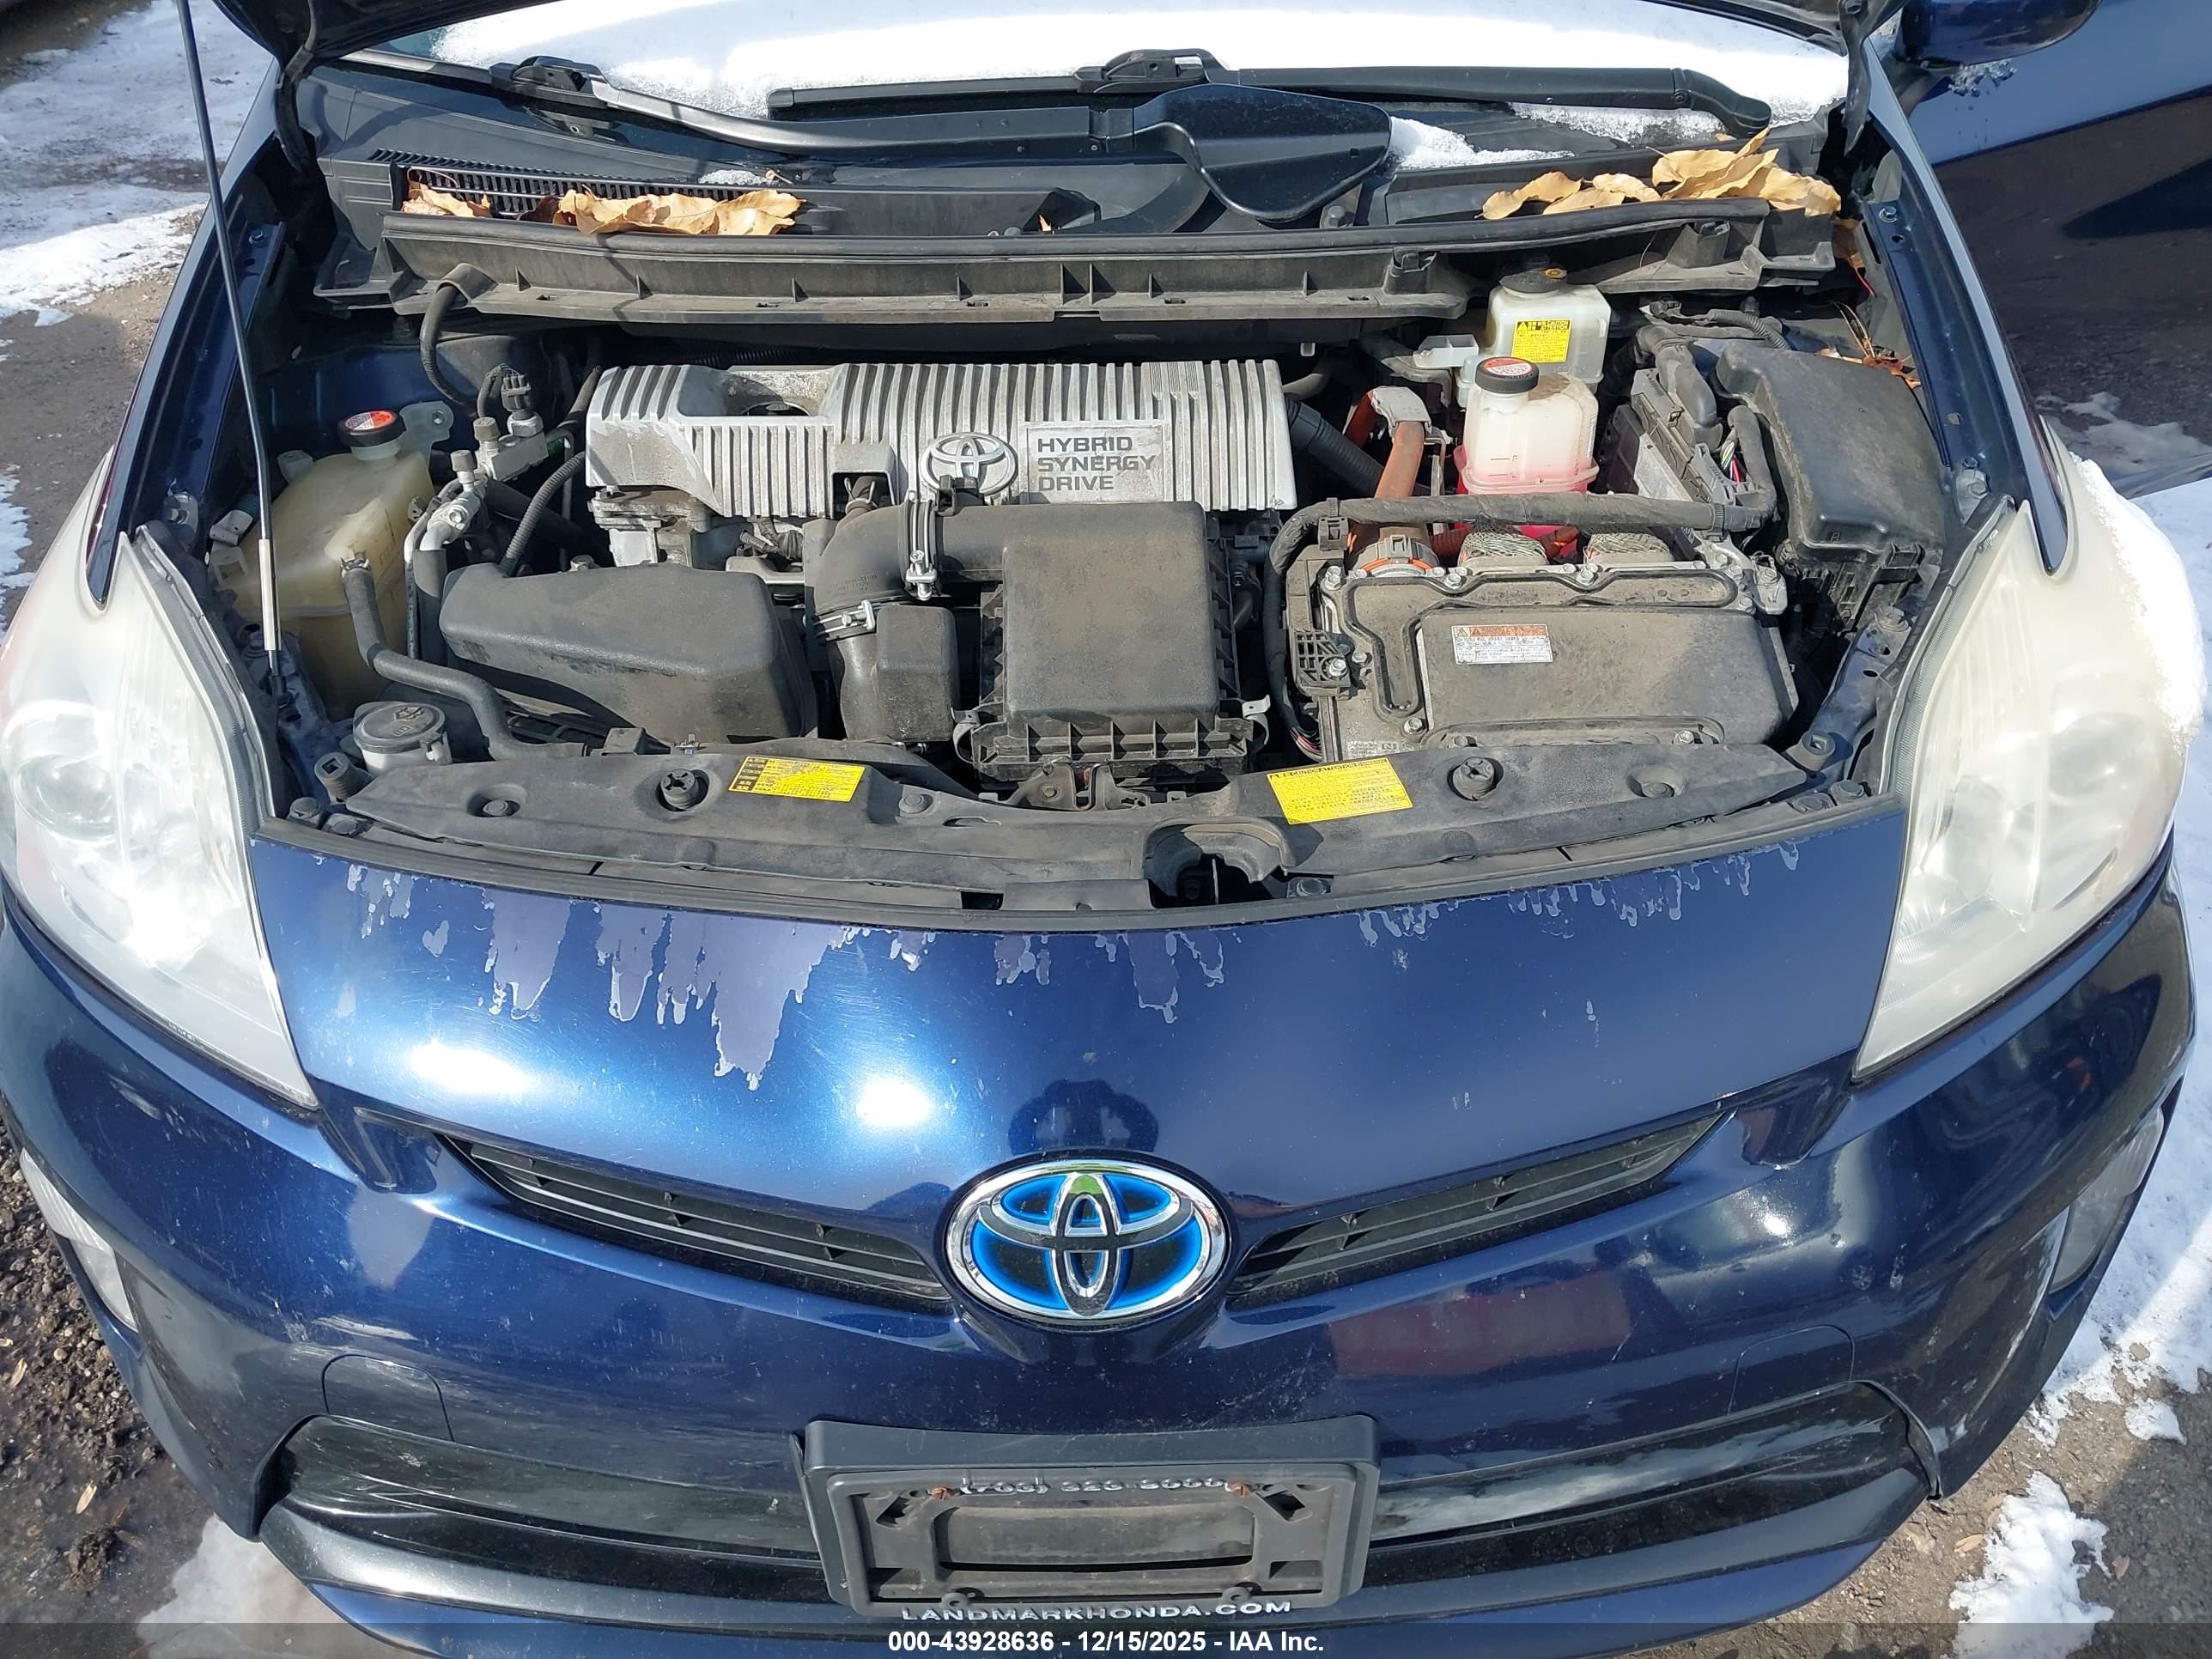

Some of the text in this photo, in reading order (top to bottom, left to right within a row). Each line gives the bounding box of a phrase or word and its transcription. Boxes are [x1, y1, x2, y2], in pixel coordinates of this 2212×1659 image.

[1037, 437, 1133, 452] HYBRID
[1037, 455, 1156, 471] SYNERGY
[1038, 476, 1114, 490] DRIVE
[902, 1601, 1291, 1620] LANDMARKHONDA.COM
